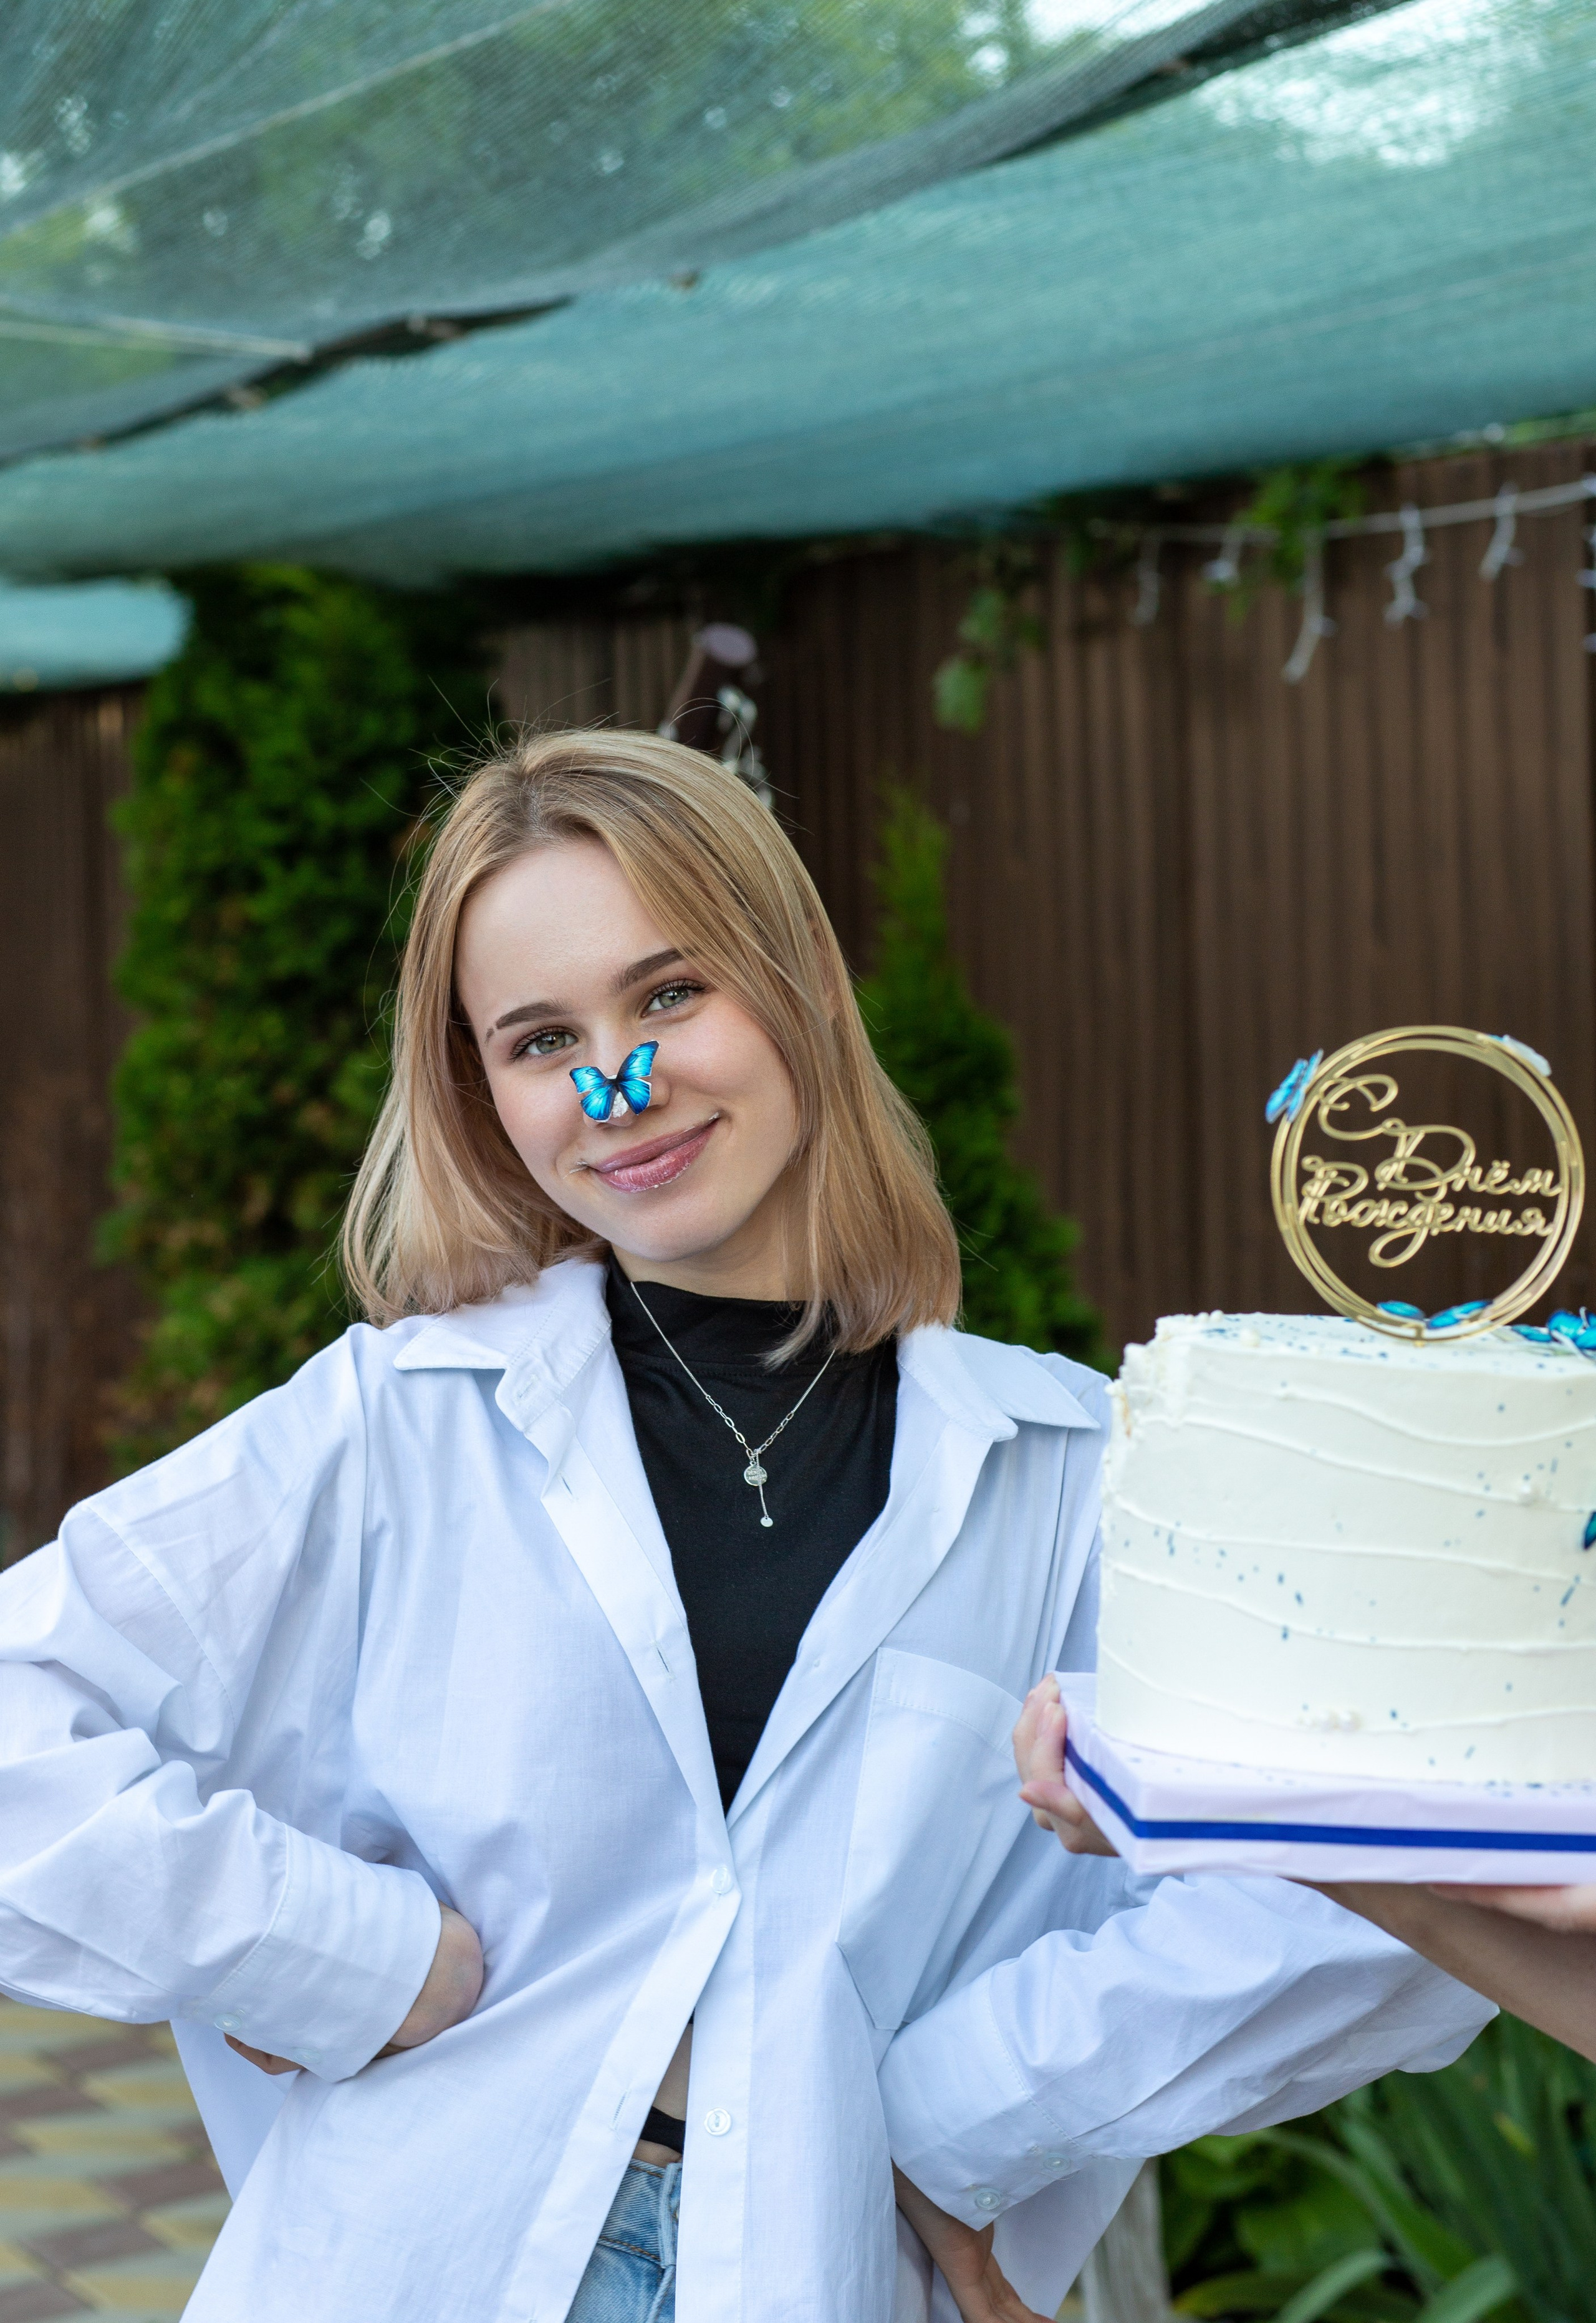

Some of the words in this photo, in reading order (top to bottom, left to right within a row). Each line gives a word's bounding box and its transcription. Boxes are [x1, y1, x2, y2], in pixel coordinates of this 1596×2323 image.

[1317, 1074, 1398, 1141] С
[1374, 1118, 1563, 1197] Днём
[1299, 1155, 1554, 1268] Рождения
